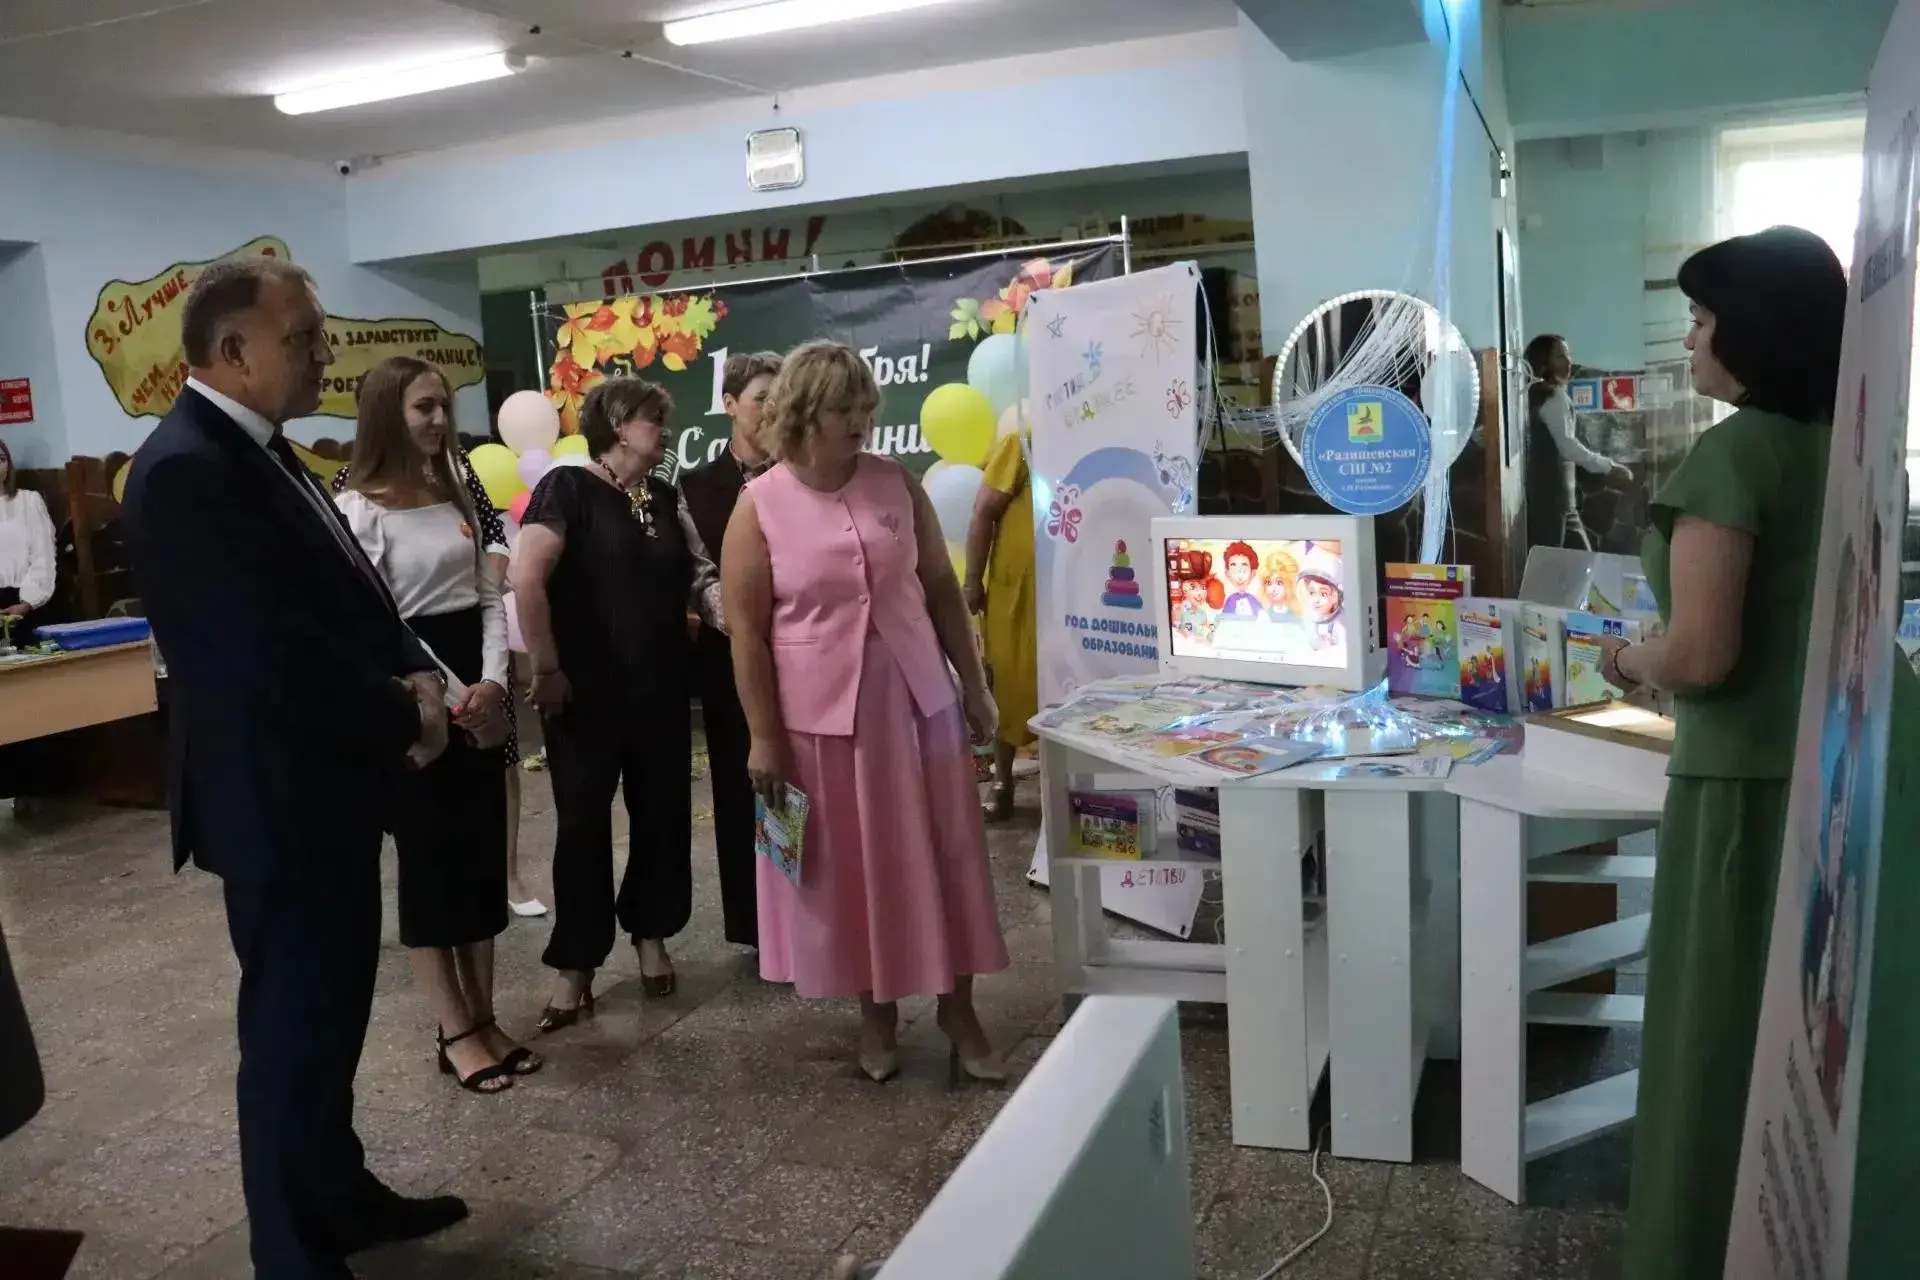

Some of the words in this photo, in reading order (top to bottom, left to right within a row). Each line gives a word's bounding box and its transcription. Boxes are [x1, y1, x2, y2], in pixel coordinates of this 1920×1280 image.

[347, 329, 439, 346] ЗДРАВСТВУЕТ
[1368, 461, 1392, 474] №2
[1065, 614, 1088, 629] ГОД
[1091, 617, 1158, 639] ДОШКОЛЬН
[1082, 637, 1159, 660] ОБРАЗОВАНИ
